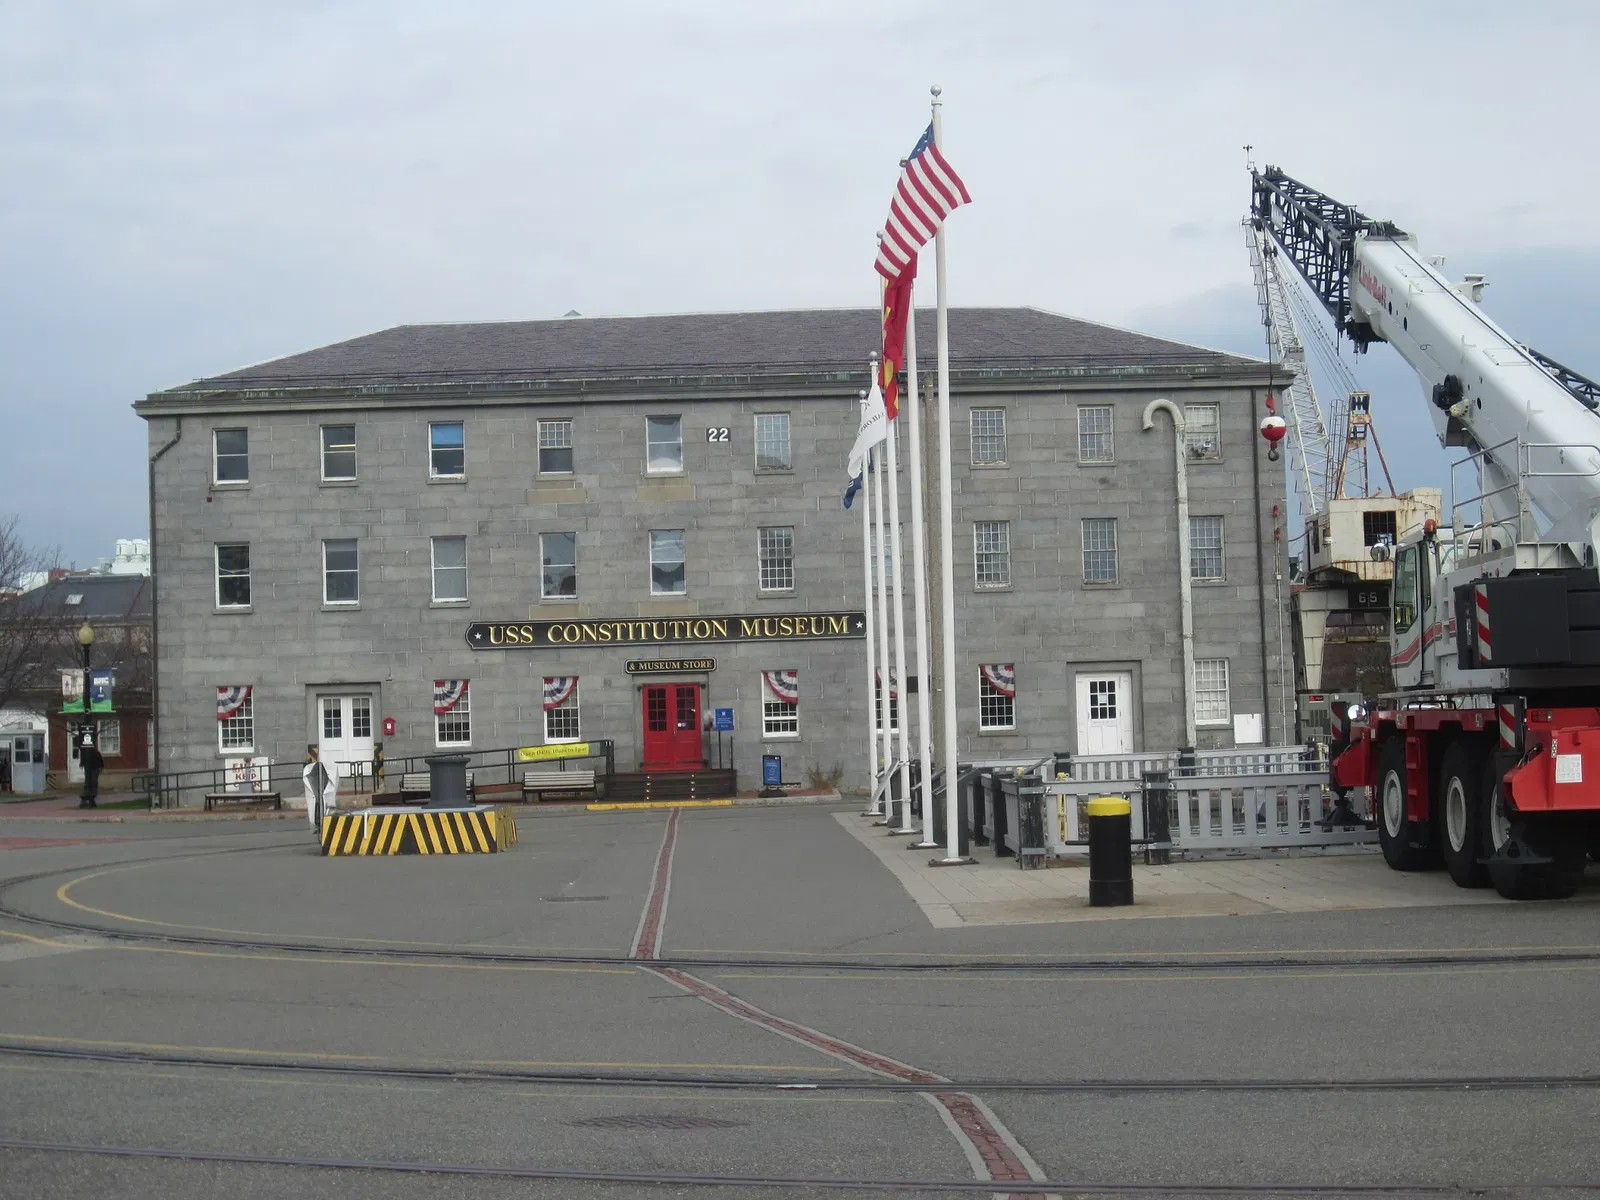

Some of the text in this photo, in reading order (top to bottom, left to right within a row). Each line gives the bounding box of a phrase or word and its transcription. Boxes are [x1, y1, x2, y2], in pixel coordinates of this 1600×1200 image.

[708, 427, 729, 442] 22
[1359, 591, 1378, 603] 65
[488, 615, 850, 645] USS CONSTITUTION MUSEUM
[628, 660, 713, 671] & MUSEUM STORE
